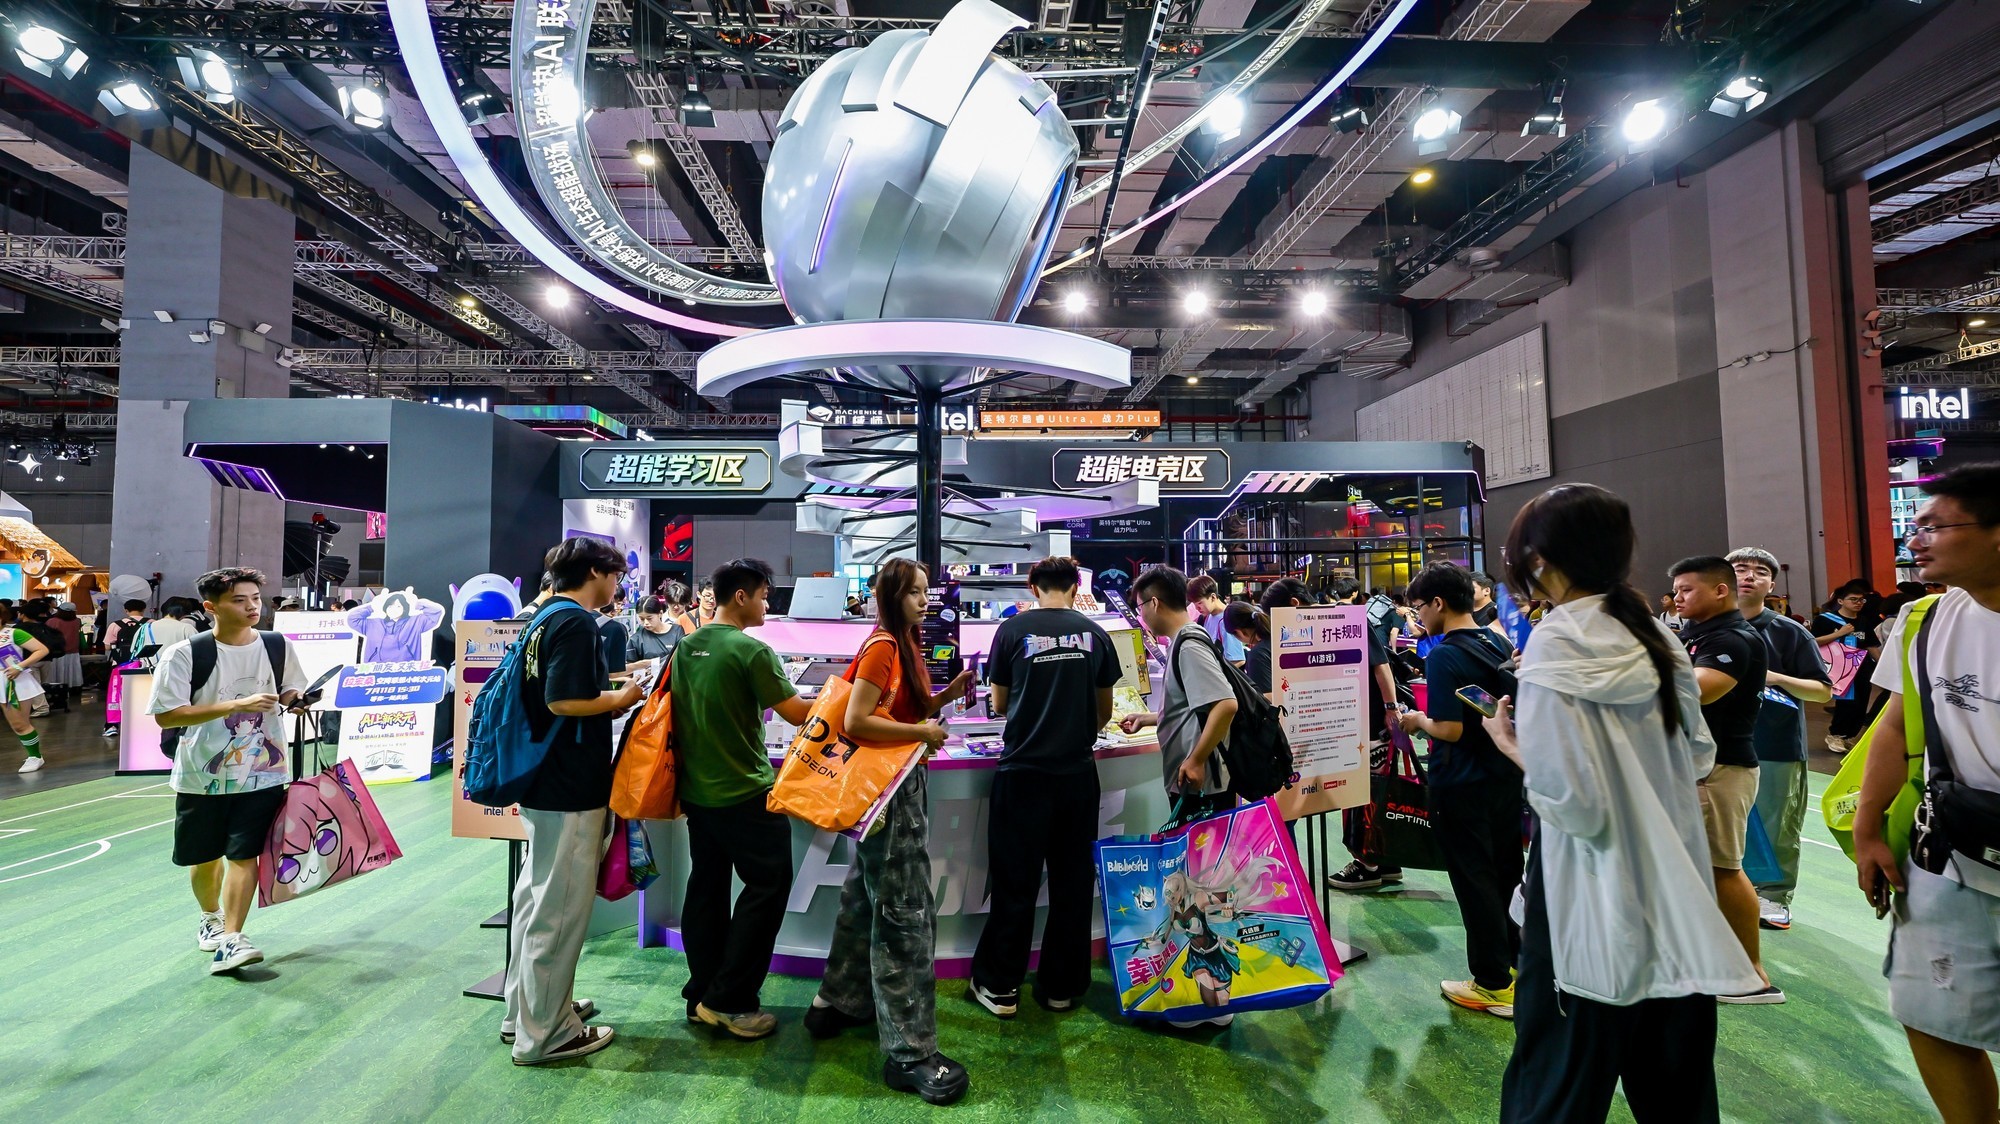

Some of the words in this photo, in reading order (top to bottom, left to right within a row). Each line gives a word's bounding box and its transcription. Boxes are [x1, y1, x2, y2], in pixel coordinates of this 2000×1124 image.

[1900, 386, 1970, 419] intel
[834, 415, 882, 425] 机械师
[604, 453, 748, 485] 超能学习区
[1076, 454, 1208, 483] 超能电竞区
[1322, 623, 1362, 643] 打卡规则
